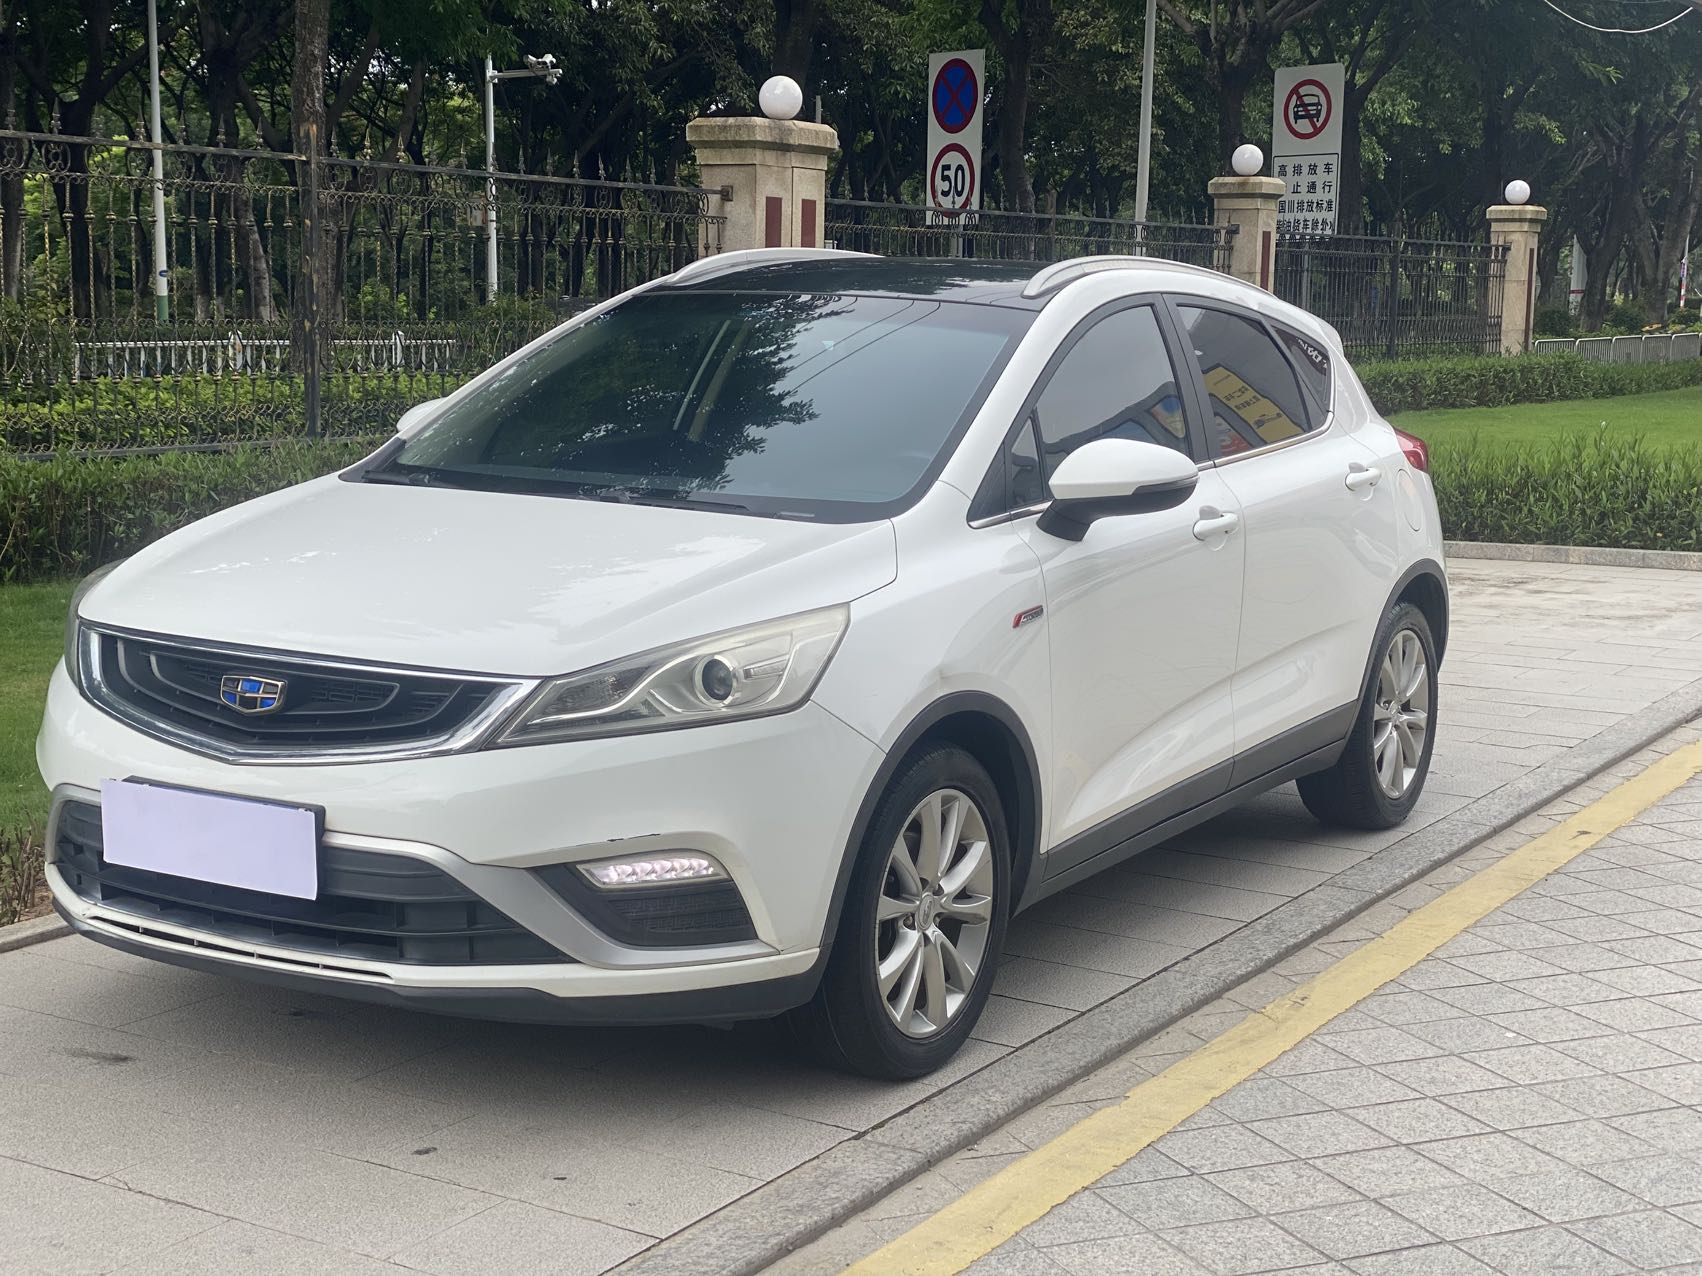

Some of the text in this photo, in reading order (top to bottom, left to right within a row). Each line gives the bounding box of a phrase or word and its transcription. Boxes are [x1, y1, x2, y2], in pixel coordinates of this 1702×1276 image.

[1278, 162, 1333, 177] 高排放车
[941, 164, 965, 197] 50
[1286, 181, 1333, 194] 止通行
